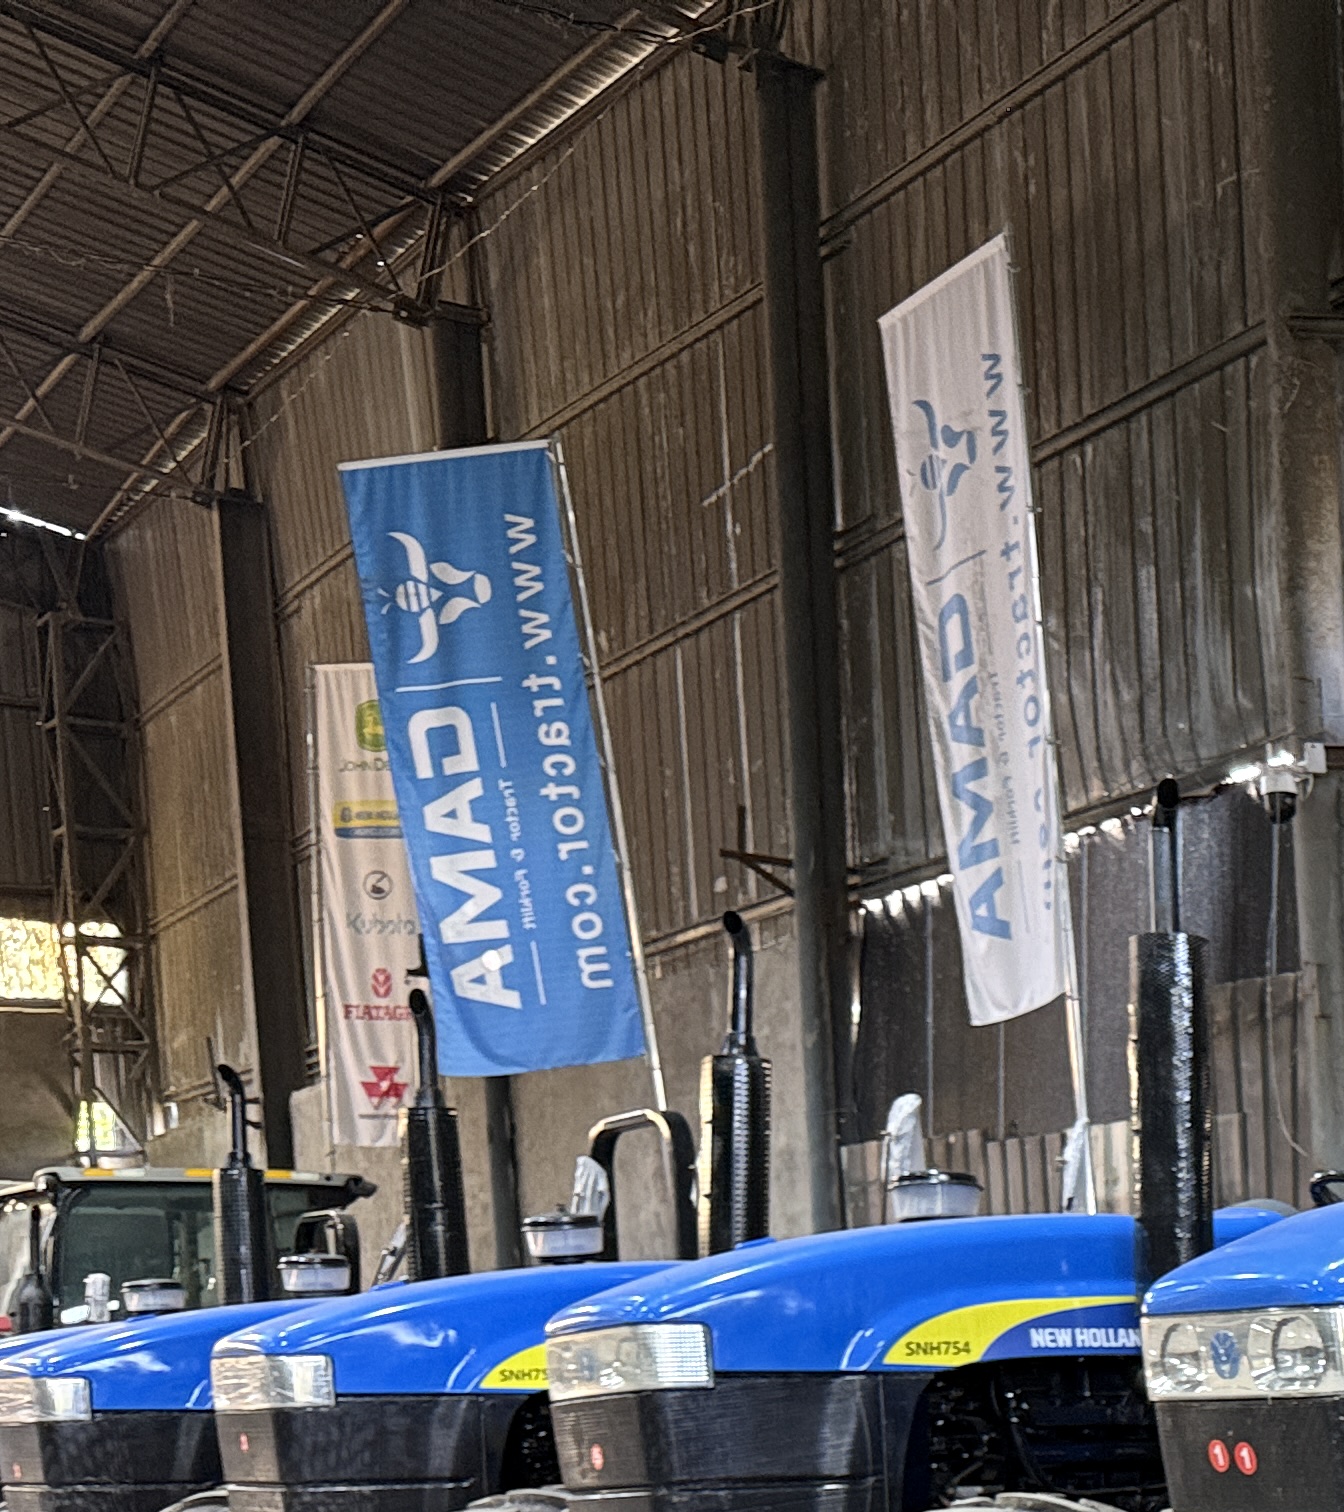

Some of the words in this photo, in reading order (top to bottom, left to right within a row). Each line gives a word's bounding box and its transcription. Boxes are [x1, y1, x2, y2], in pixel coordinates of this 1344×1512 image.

[1029, 1327, 1074, 1348] NEW
[1075, 1327, 1141, 1348] HOLLAN
[904, 1340, 971, 1357] SNH754
[499, 1368, 547, 1383] SNH75
[1213, 1444, 1225, 1467] 1
[1240, 1447, 1252, 1470] 1
